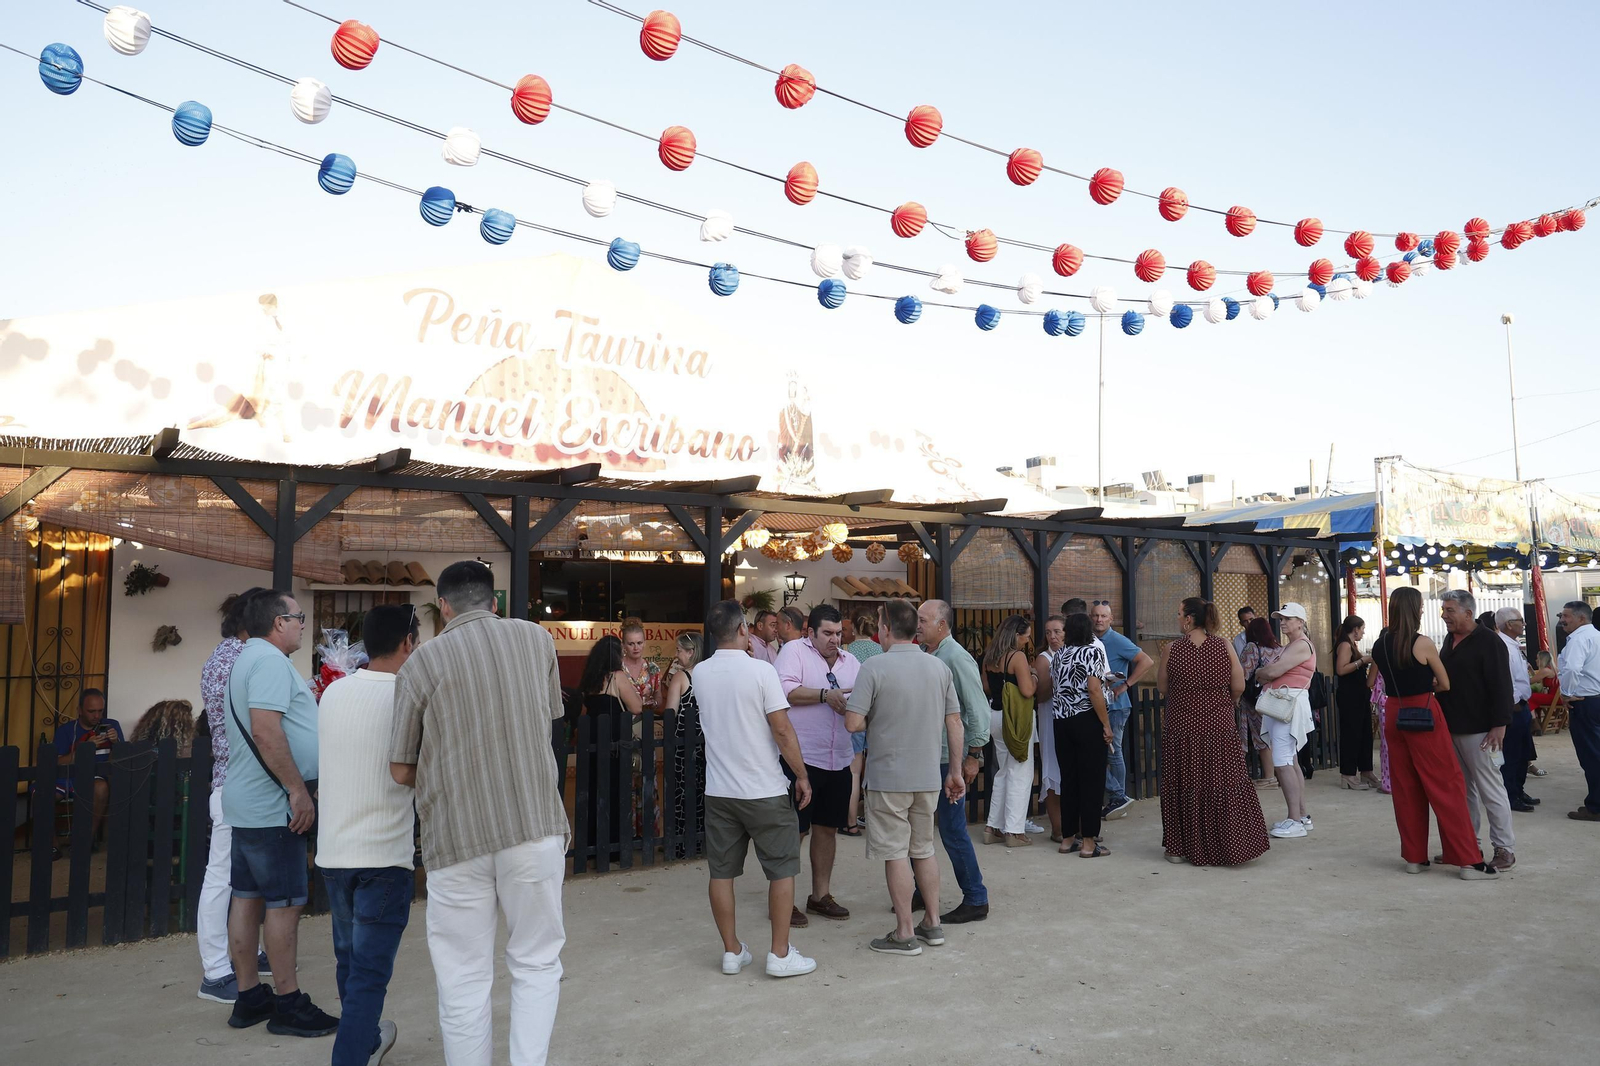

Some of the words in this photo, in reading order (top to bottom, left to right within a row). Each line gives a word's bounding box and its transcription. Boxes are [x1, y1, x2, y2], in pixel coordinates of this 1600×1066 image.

[403, 287, 536, 352] Peña
[555, 309, 712, 378] Taurina
[332, 369, 541, 440] Manuel
[556, 396, 760, 462] Escribano
[1433, 503, 1449, 520] EL
[547, 627, 598, 640] ANUEL
